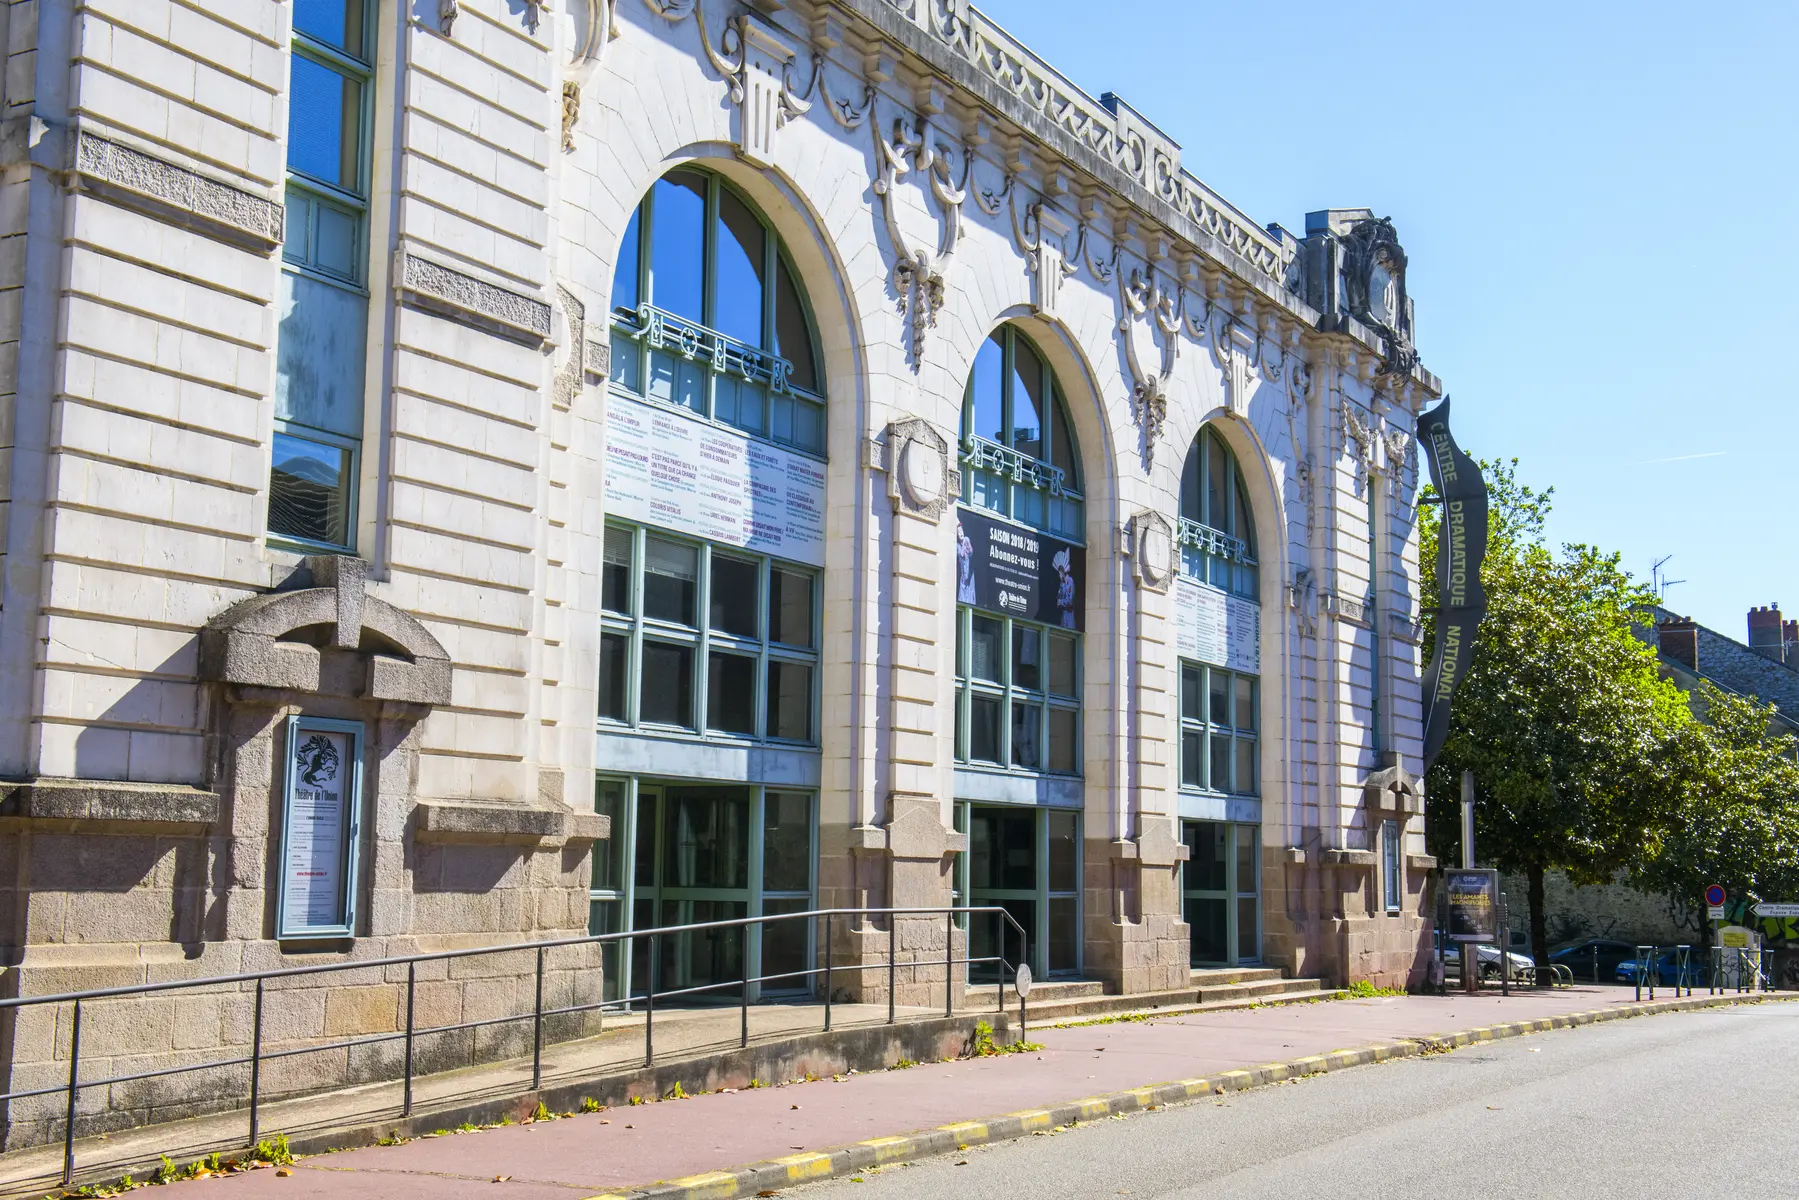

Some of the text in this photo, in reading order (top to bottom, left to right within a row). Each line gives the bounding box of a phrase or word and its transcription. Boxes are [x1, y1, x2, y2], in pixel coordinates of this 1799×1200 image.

[990, 527, 1010, 545] SAISON
[1010, 533, 1024, 550] 2018
[1026, 538, 1040, 554] 2019
[990, 544, 1036, 570] Abonnez-vous
[1430, 421, 1467, 703] CENTRE DRAMATIQUE NATIONAL
[294, 788, 338, 801] Théâtre de l'Union
